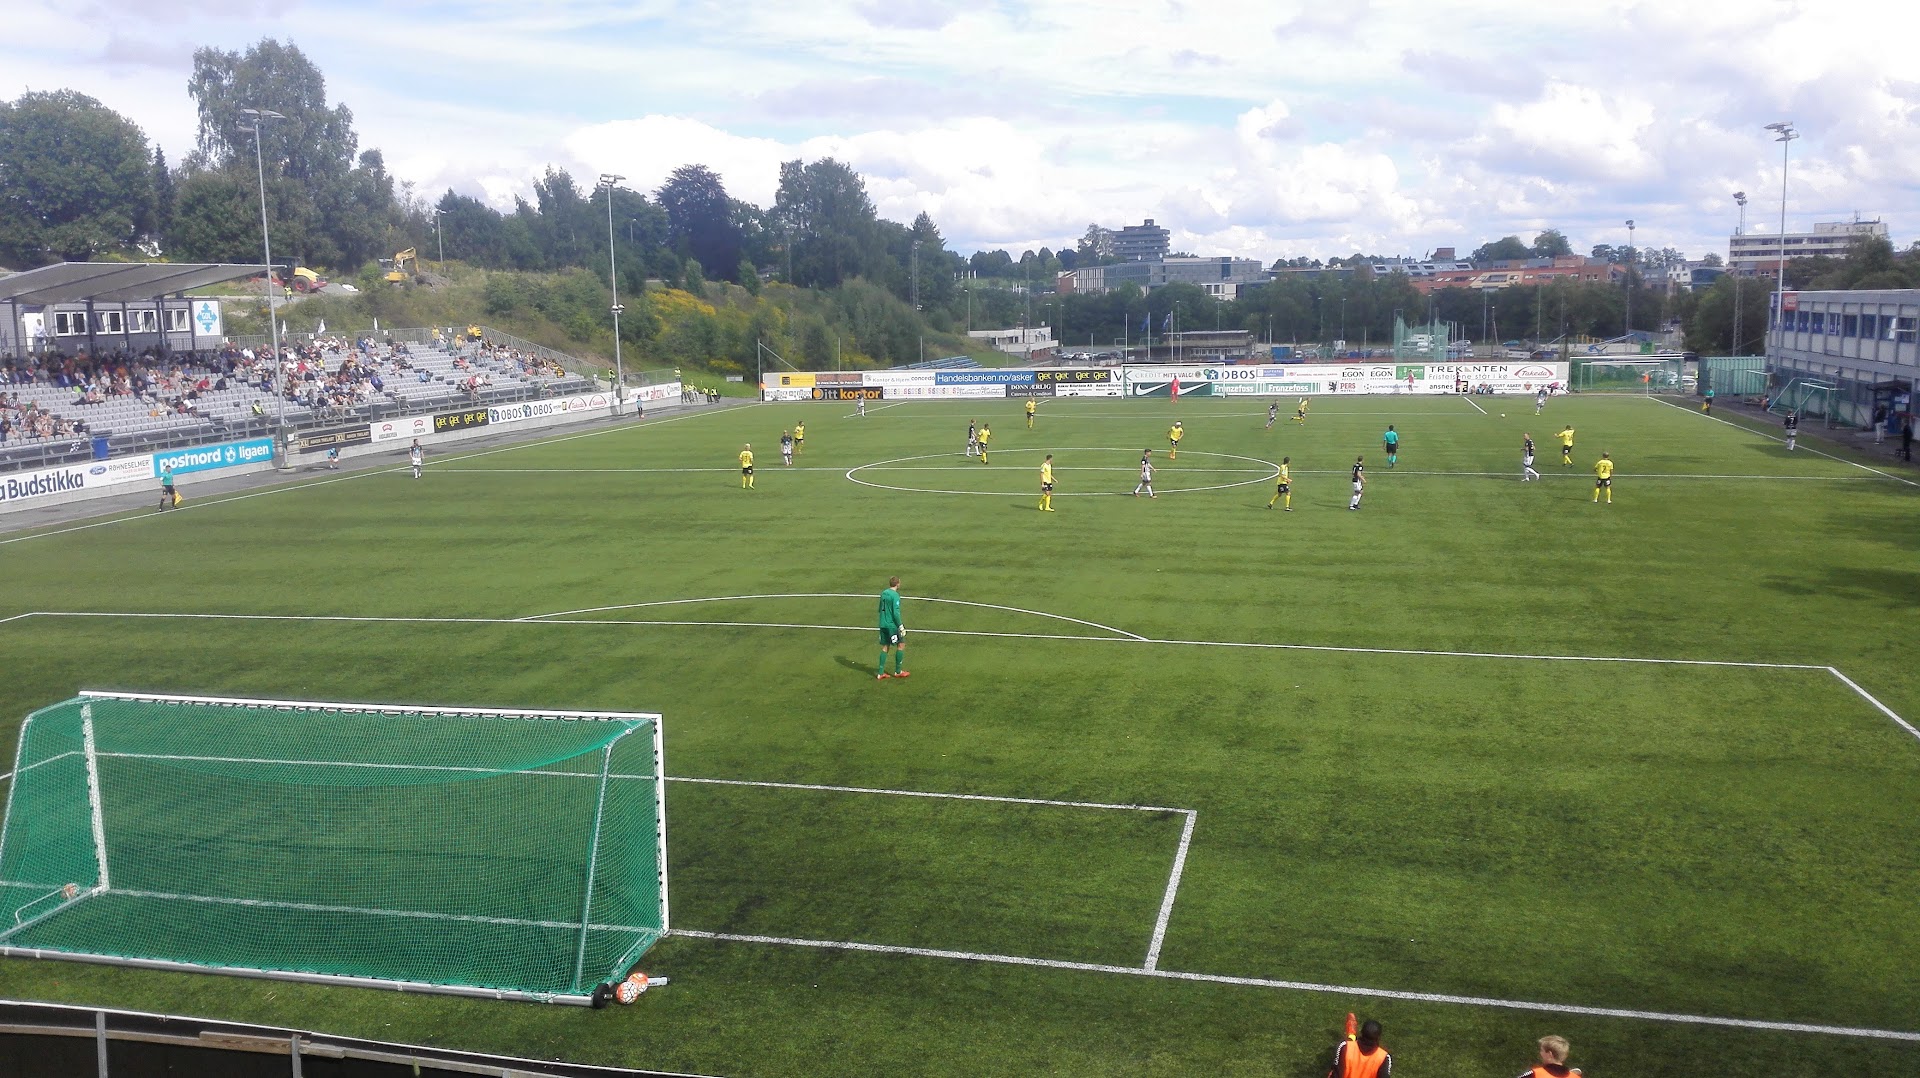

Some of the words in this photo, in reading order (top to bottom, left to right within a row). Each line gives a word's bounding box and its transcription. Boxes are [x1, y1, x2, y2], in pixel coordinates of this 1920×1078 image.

[937, 372, 1034, 382] Handelsbanken.no/asker
[1222, 370, 1256, 380] OBOS
[840, 388, 880, 400] kontor
[1268, 384, 1309, 392] Franzefoss
[501, 407, 522, 420] OBOS
[532, 403, 552, 416] OBOS
[239, 444, 269, 460] ligaen
[160, 448, 222, 473] postnord
[7, 470, 84, 499] Budstikka
